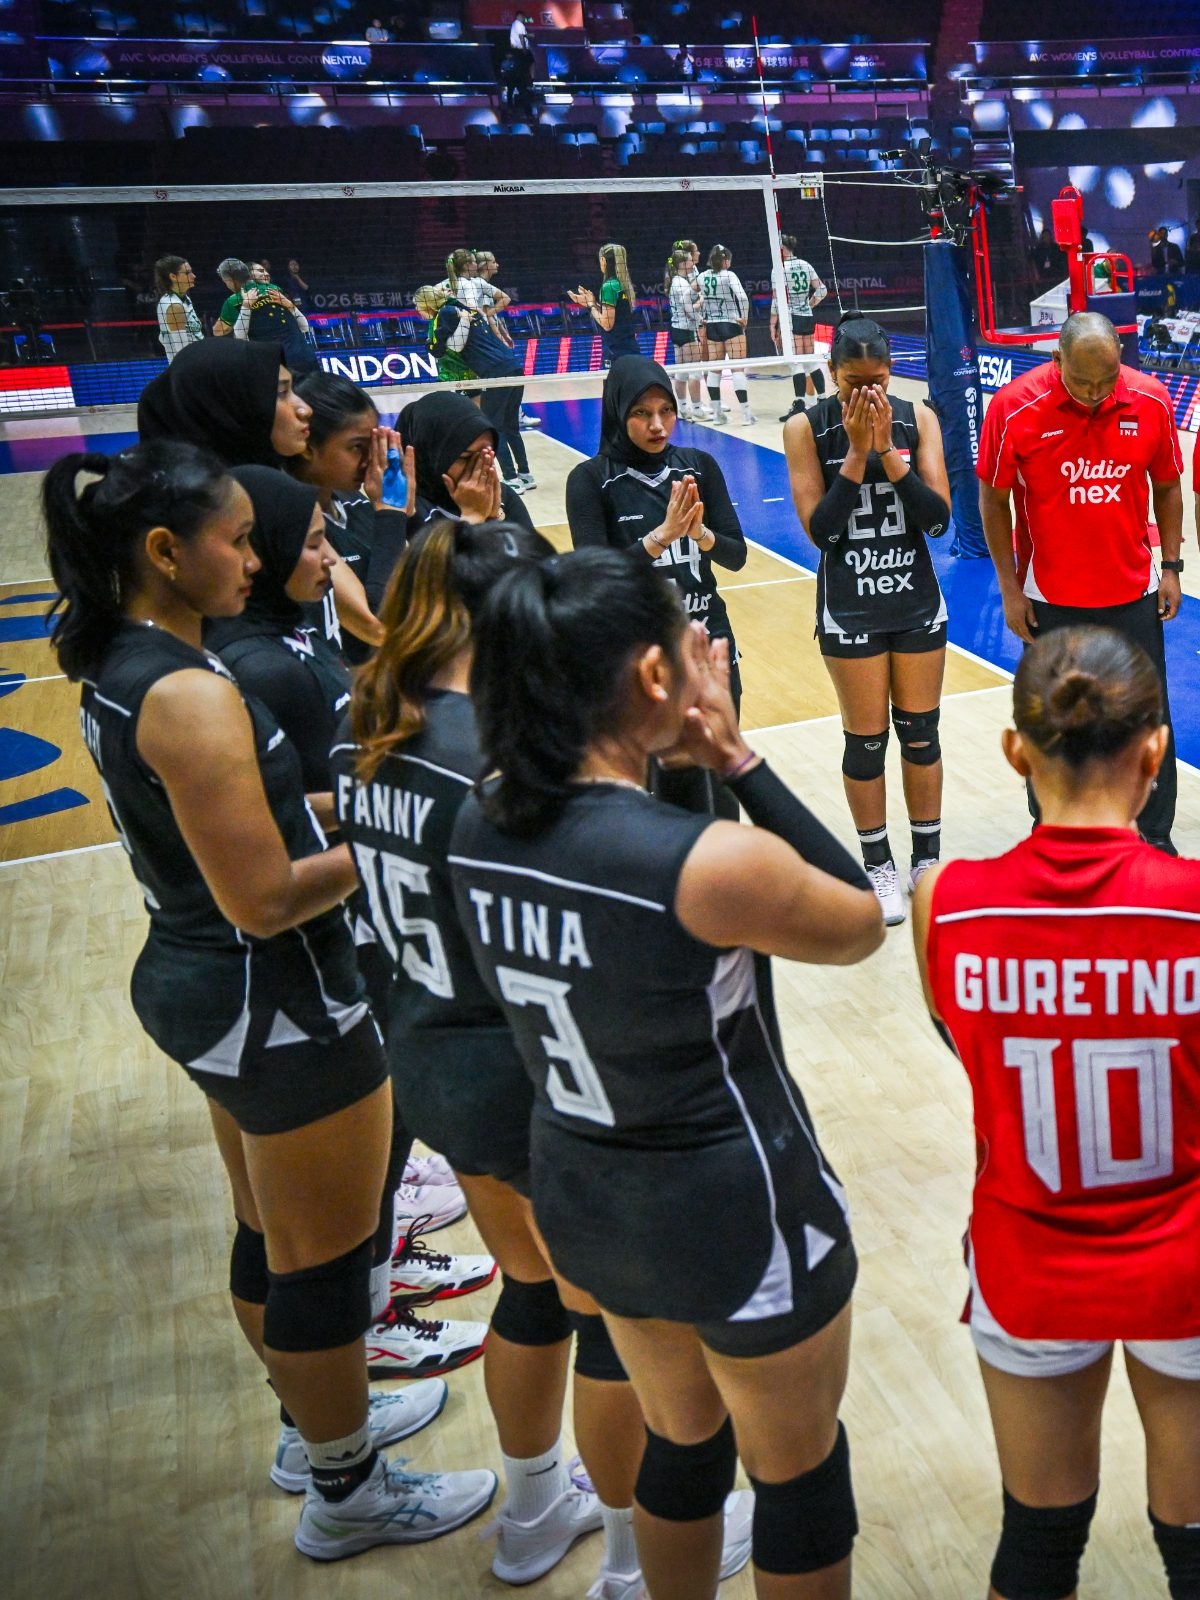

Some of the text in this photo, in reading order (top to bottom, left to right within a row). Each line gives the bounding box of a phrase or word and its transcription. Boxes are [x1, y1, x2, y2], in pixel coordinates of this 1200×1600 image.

[120, 53, 143, 63] AVC
[212, 54, 281, 65] VOLLEYBALL
[288, 54, 366, 66] CONTINENTAL
[1029, 53, 1048, 62] AVC
[1100, 50, 1157, 61] VOLLEYBALL
[703, 277, 717, 297] 39
[791, 271, 808, 293] 33
[1060, 457, 1131, 483] Vidio
[1069, 484, 1121, 505] nex
[848, 482, 907, 540] 23
[845, 547, 916, 575] Vidio
[857, 572, 914, 596] nex
[338, 774, 436, 845] FANNY
[352, 841, 456, 1000] 15
[469, 887, 593, 969] TINA
[495, 964, 616, 1127] 3
[1002, 1036, 1180, 1194] 10
